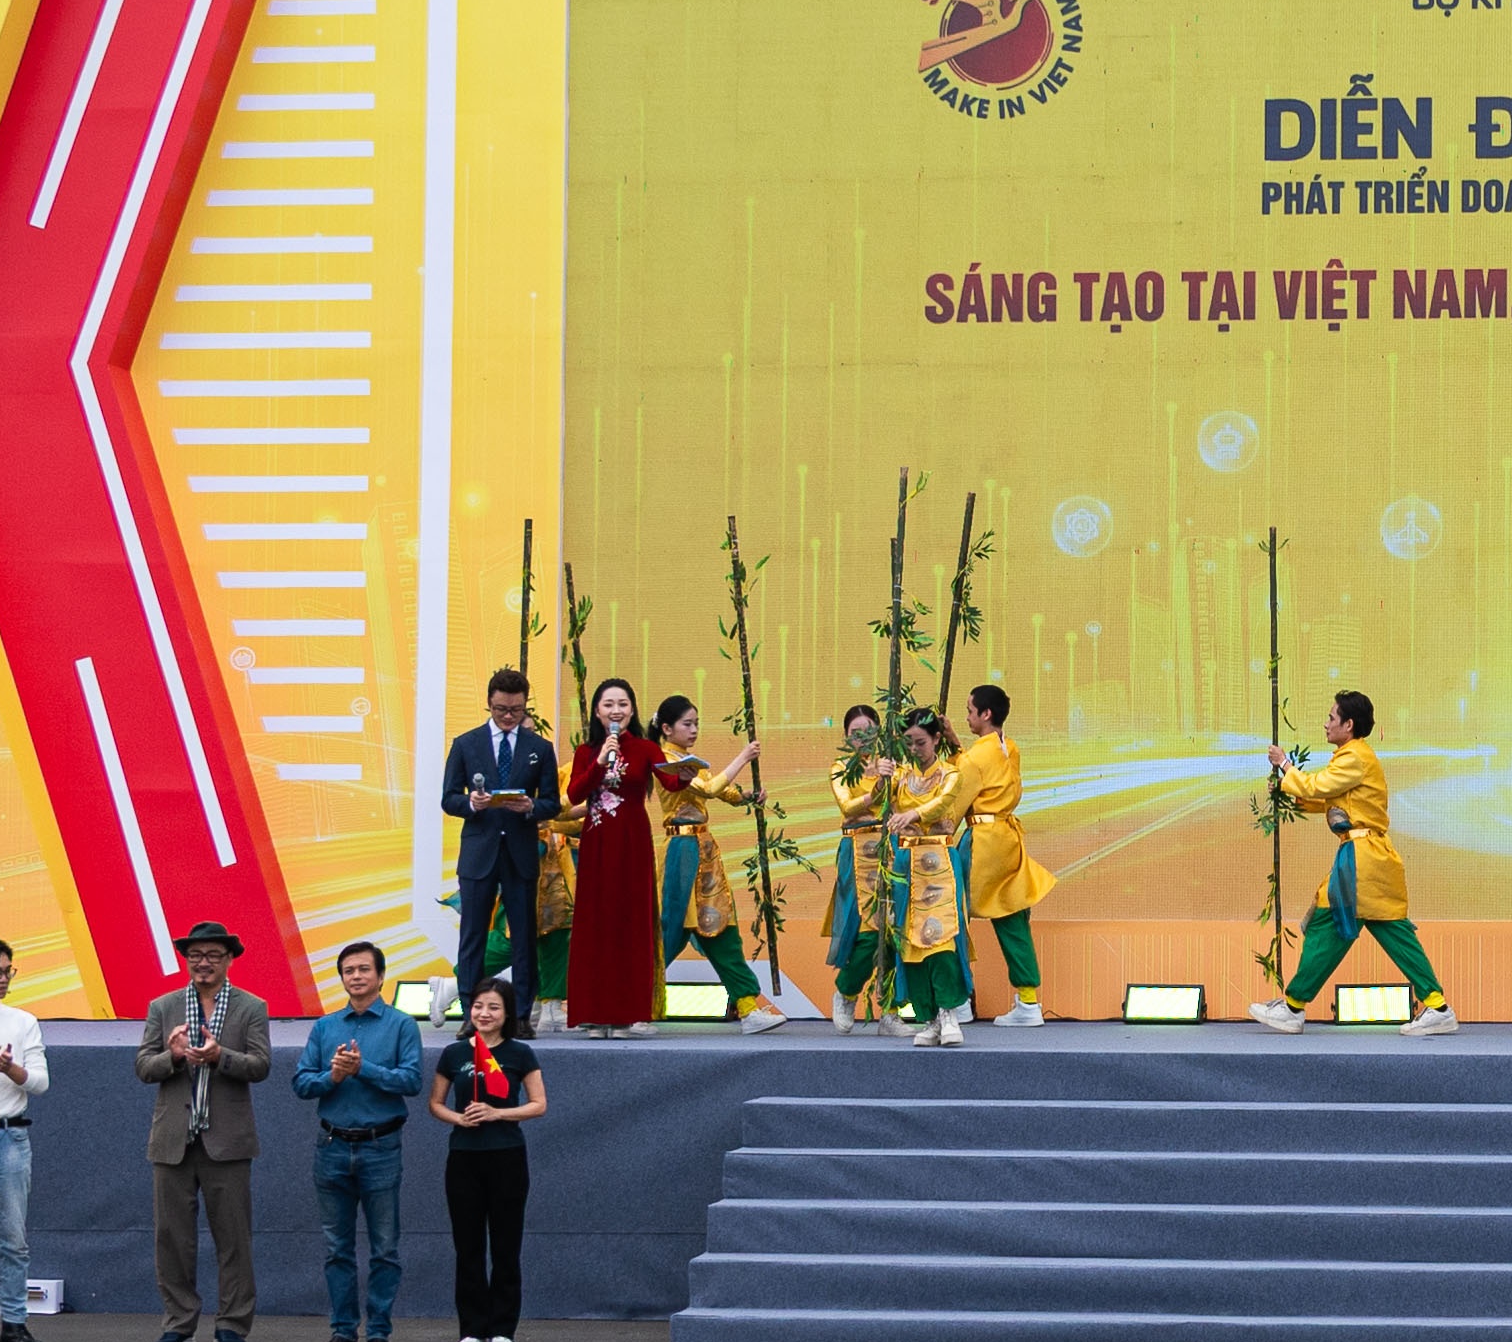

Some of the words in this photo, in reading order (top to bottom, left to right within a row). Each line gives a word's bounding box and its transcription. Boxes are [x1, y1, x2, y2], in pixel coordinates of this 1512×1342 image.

[923, 67, 990, 119] MAKE
[998, 96, 1026, 119] IN
[1028, 57, 1075, 105] VIET
[1263, 74, 1433, 161] DIỄN
[1262, 172, 1345, 215] PHÁT
[1355, 168, 1448, 214] TRIỂN
[924, 262, 1057, 324] SÁNG
[1073, 270, 1165, 333] TẠO
[1182, 270, 1256, 333] TẠI
[1273, 258, 1376, 332] VIỆT
